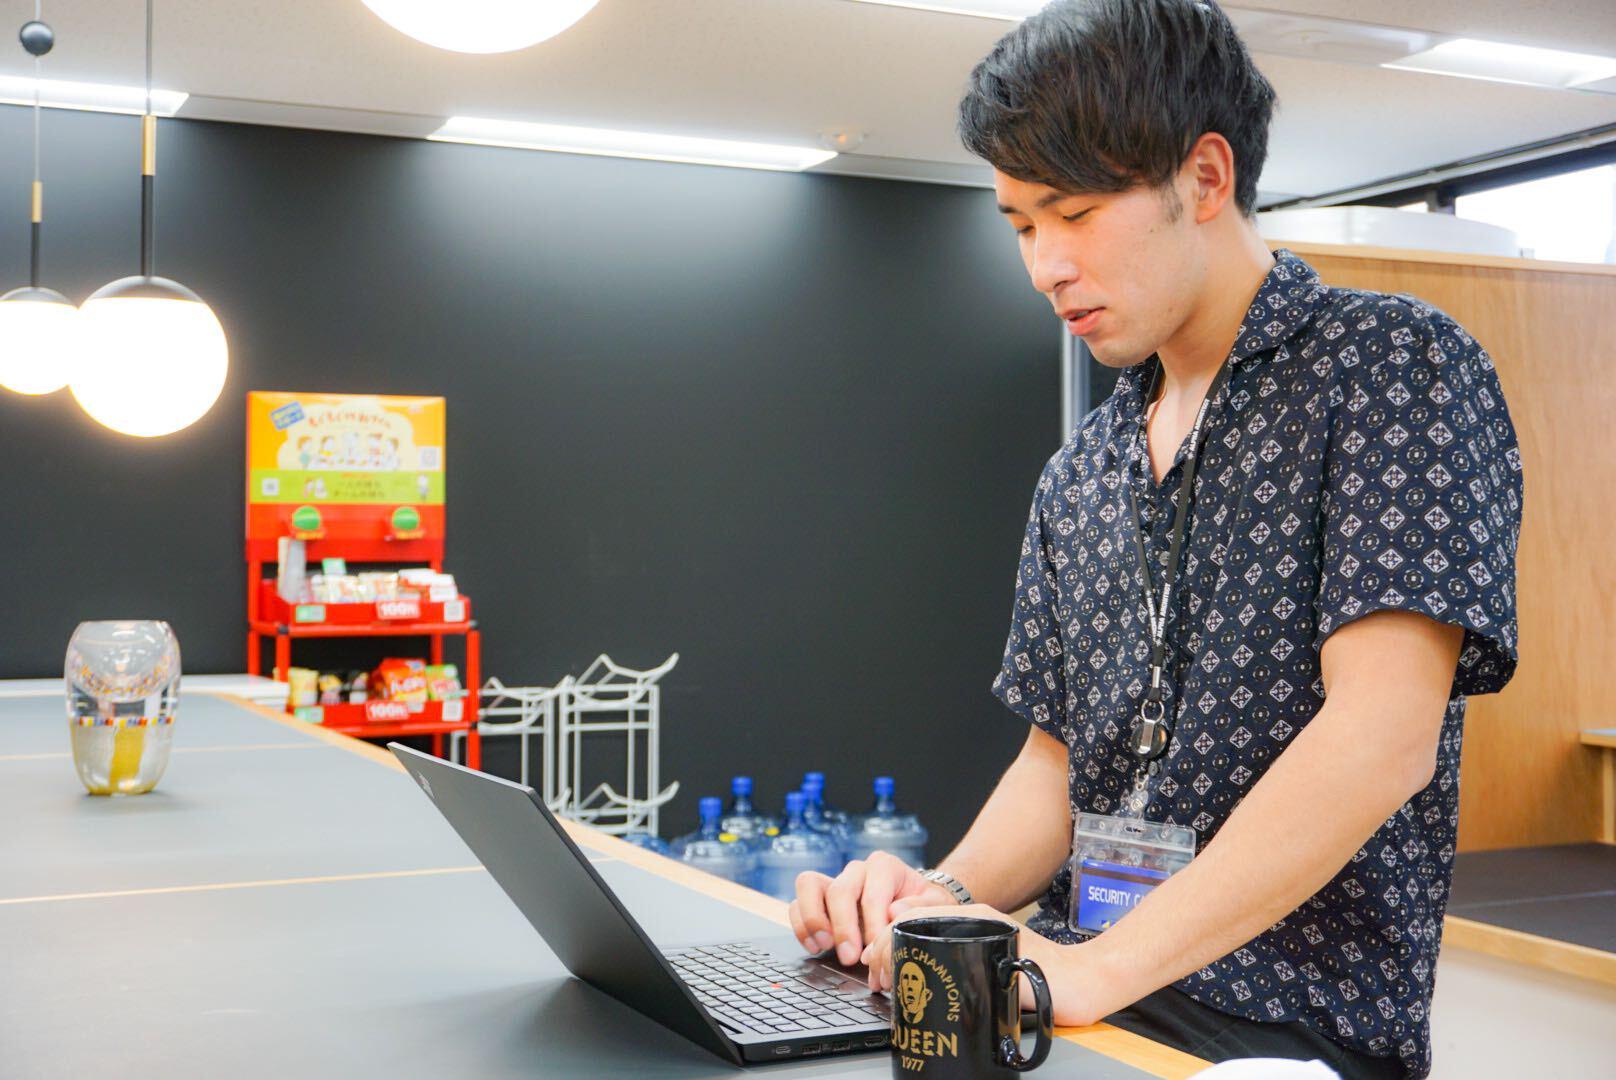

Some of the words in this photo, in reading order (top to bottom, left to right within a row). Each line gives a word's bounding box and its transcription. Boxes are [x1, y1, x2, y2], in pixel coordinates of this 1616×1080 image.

[1088, 885, 1132, 907] SECURITY
[911, 947, 961, 1022] CHAMPIONS
[901, 1055, 924, 1072] 1977
